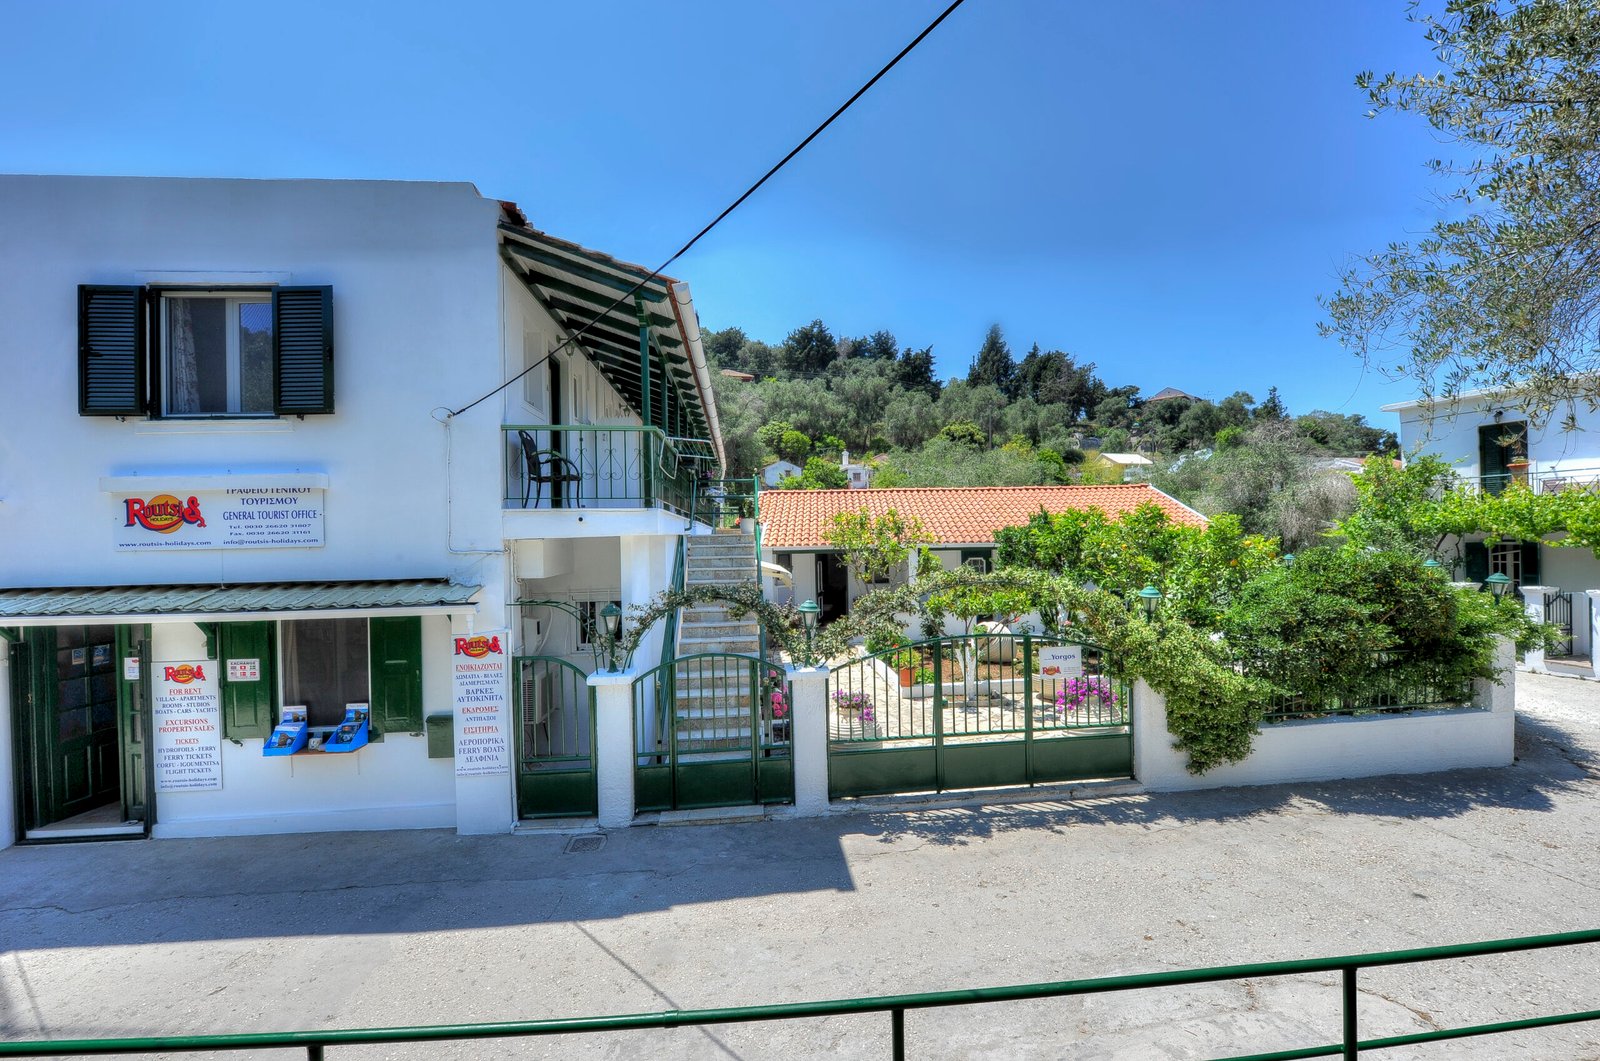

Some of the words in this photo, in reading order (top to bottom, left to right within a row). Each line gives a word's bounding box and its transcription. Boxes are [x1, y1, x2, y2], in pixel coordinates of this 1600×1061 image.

[240, 497, 298, 506] ΤΟΥΡΙΣΜΟΥ
[122, 496, 207, 531] Routsis
[222, 511, 256, 520] GENERAL
[257, 510, 289, 520] TOURIST
[291, 510, 317, 519] OFFICE
